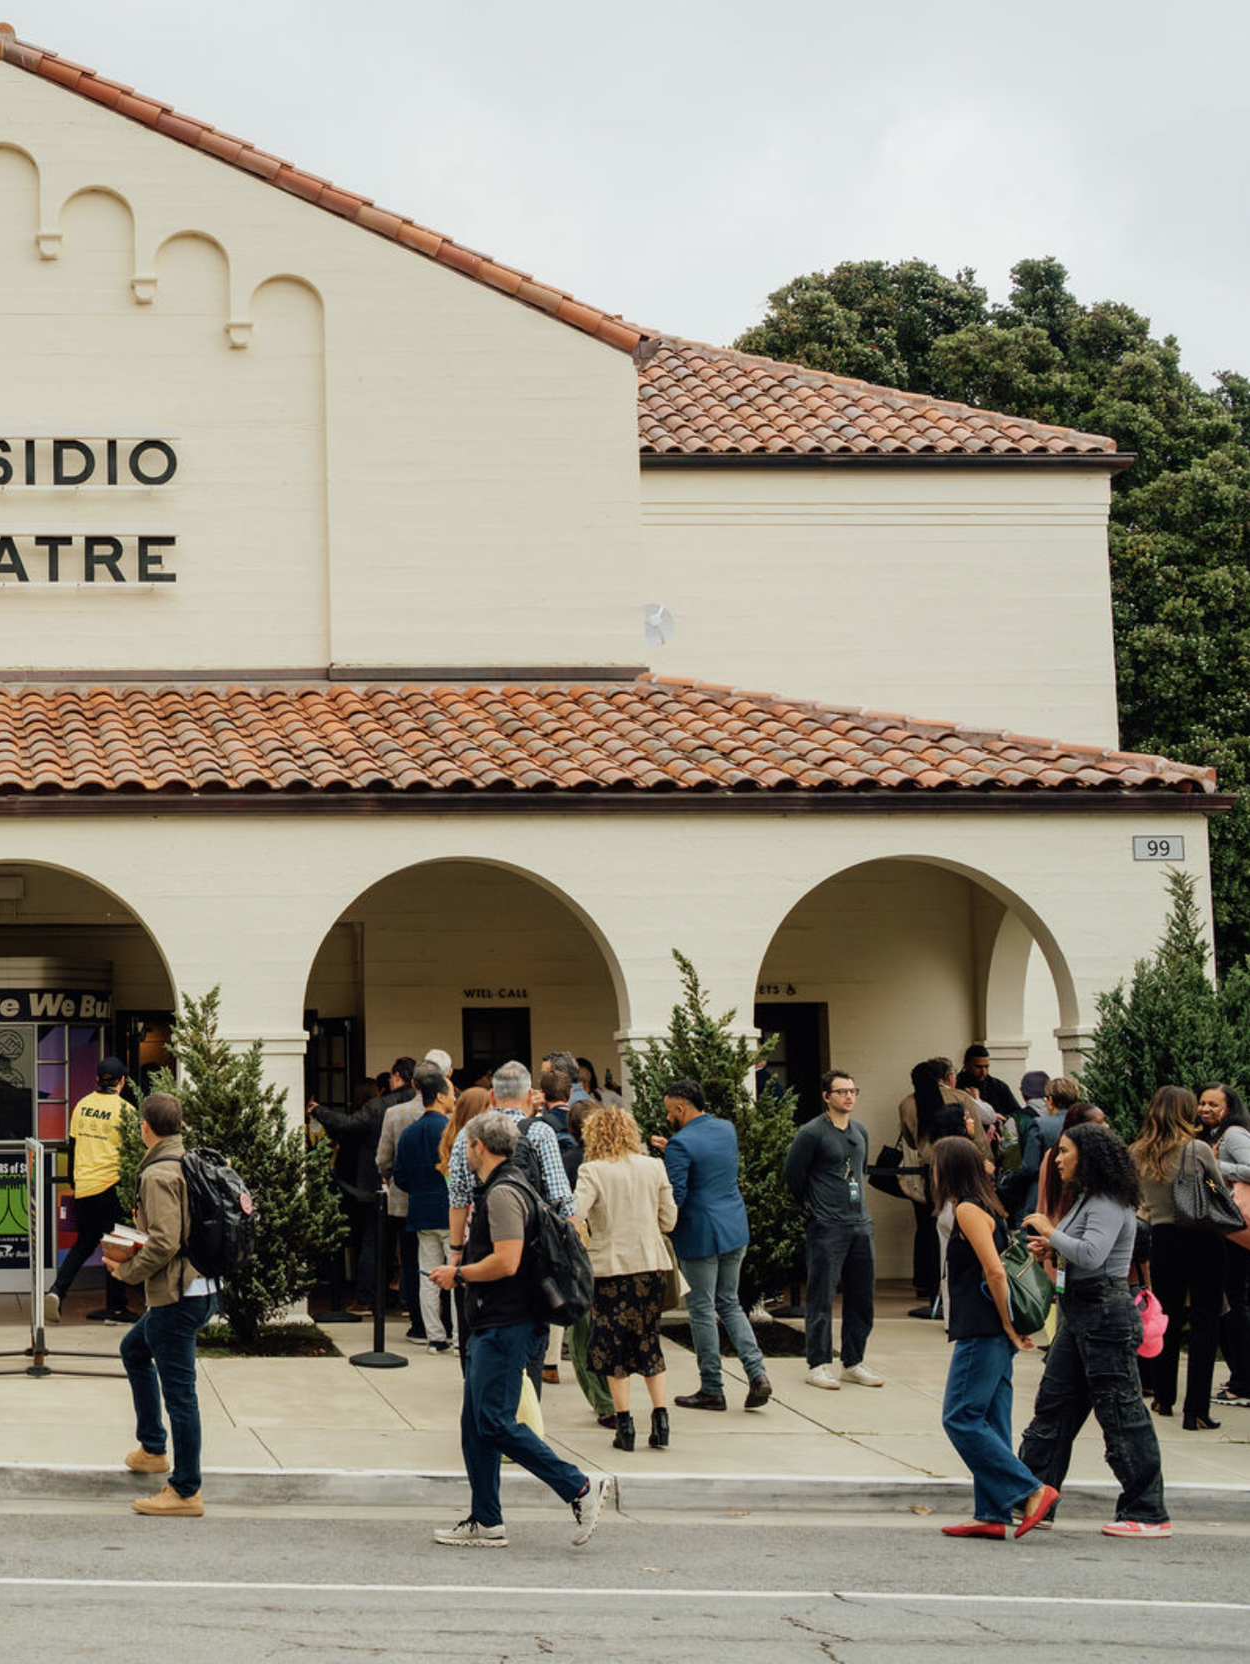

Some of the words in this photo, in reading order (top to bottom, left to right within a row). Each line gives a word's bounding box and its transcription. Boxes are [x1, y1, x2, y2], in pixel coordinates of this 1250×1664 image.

[1147, 840, 1170, 856] 99
[464, 988, 493, 999] WILL
[498, 988, 528, 999] CALL
[755, 985, 780, 995] ETS
[29, 993, 76, 1017] We
[81, 1107, 111, 1120] TEAM
[10, 1162, 18, 1173] of
